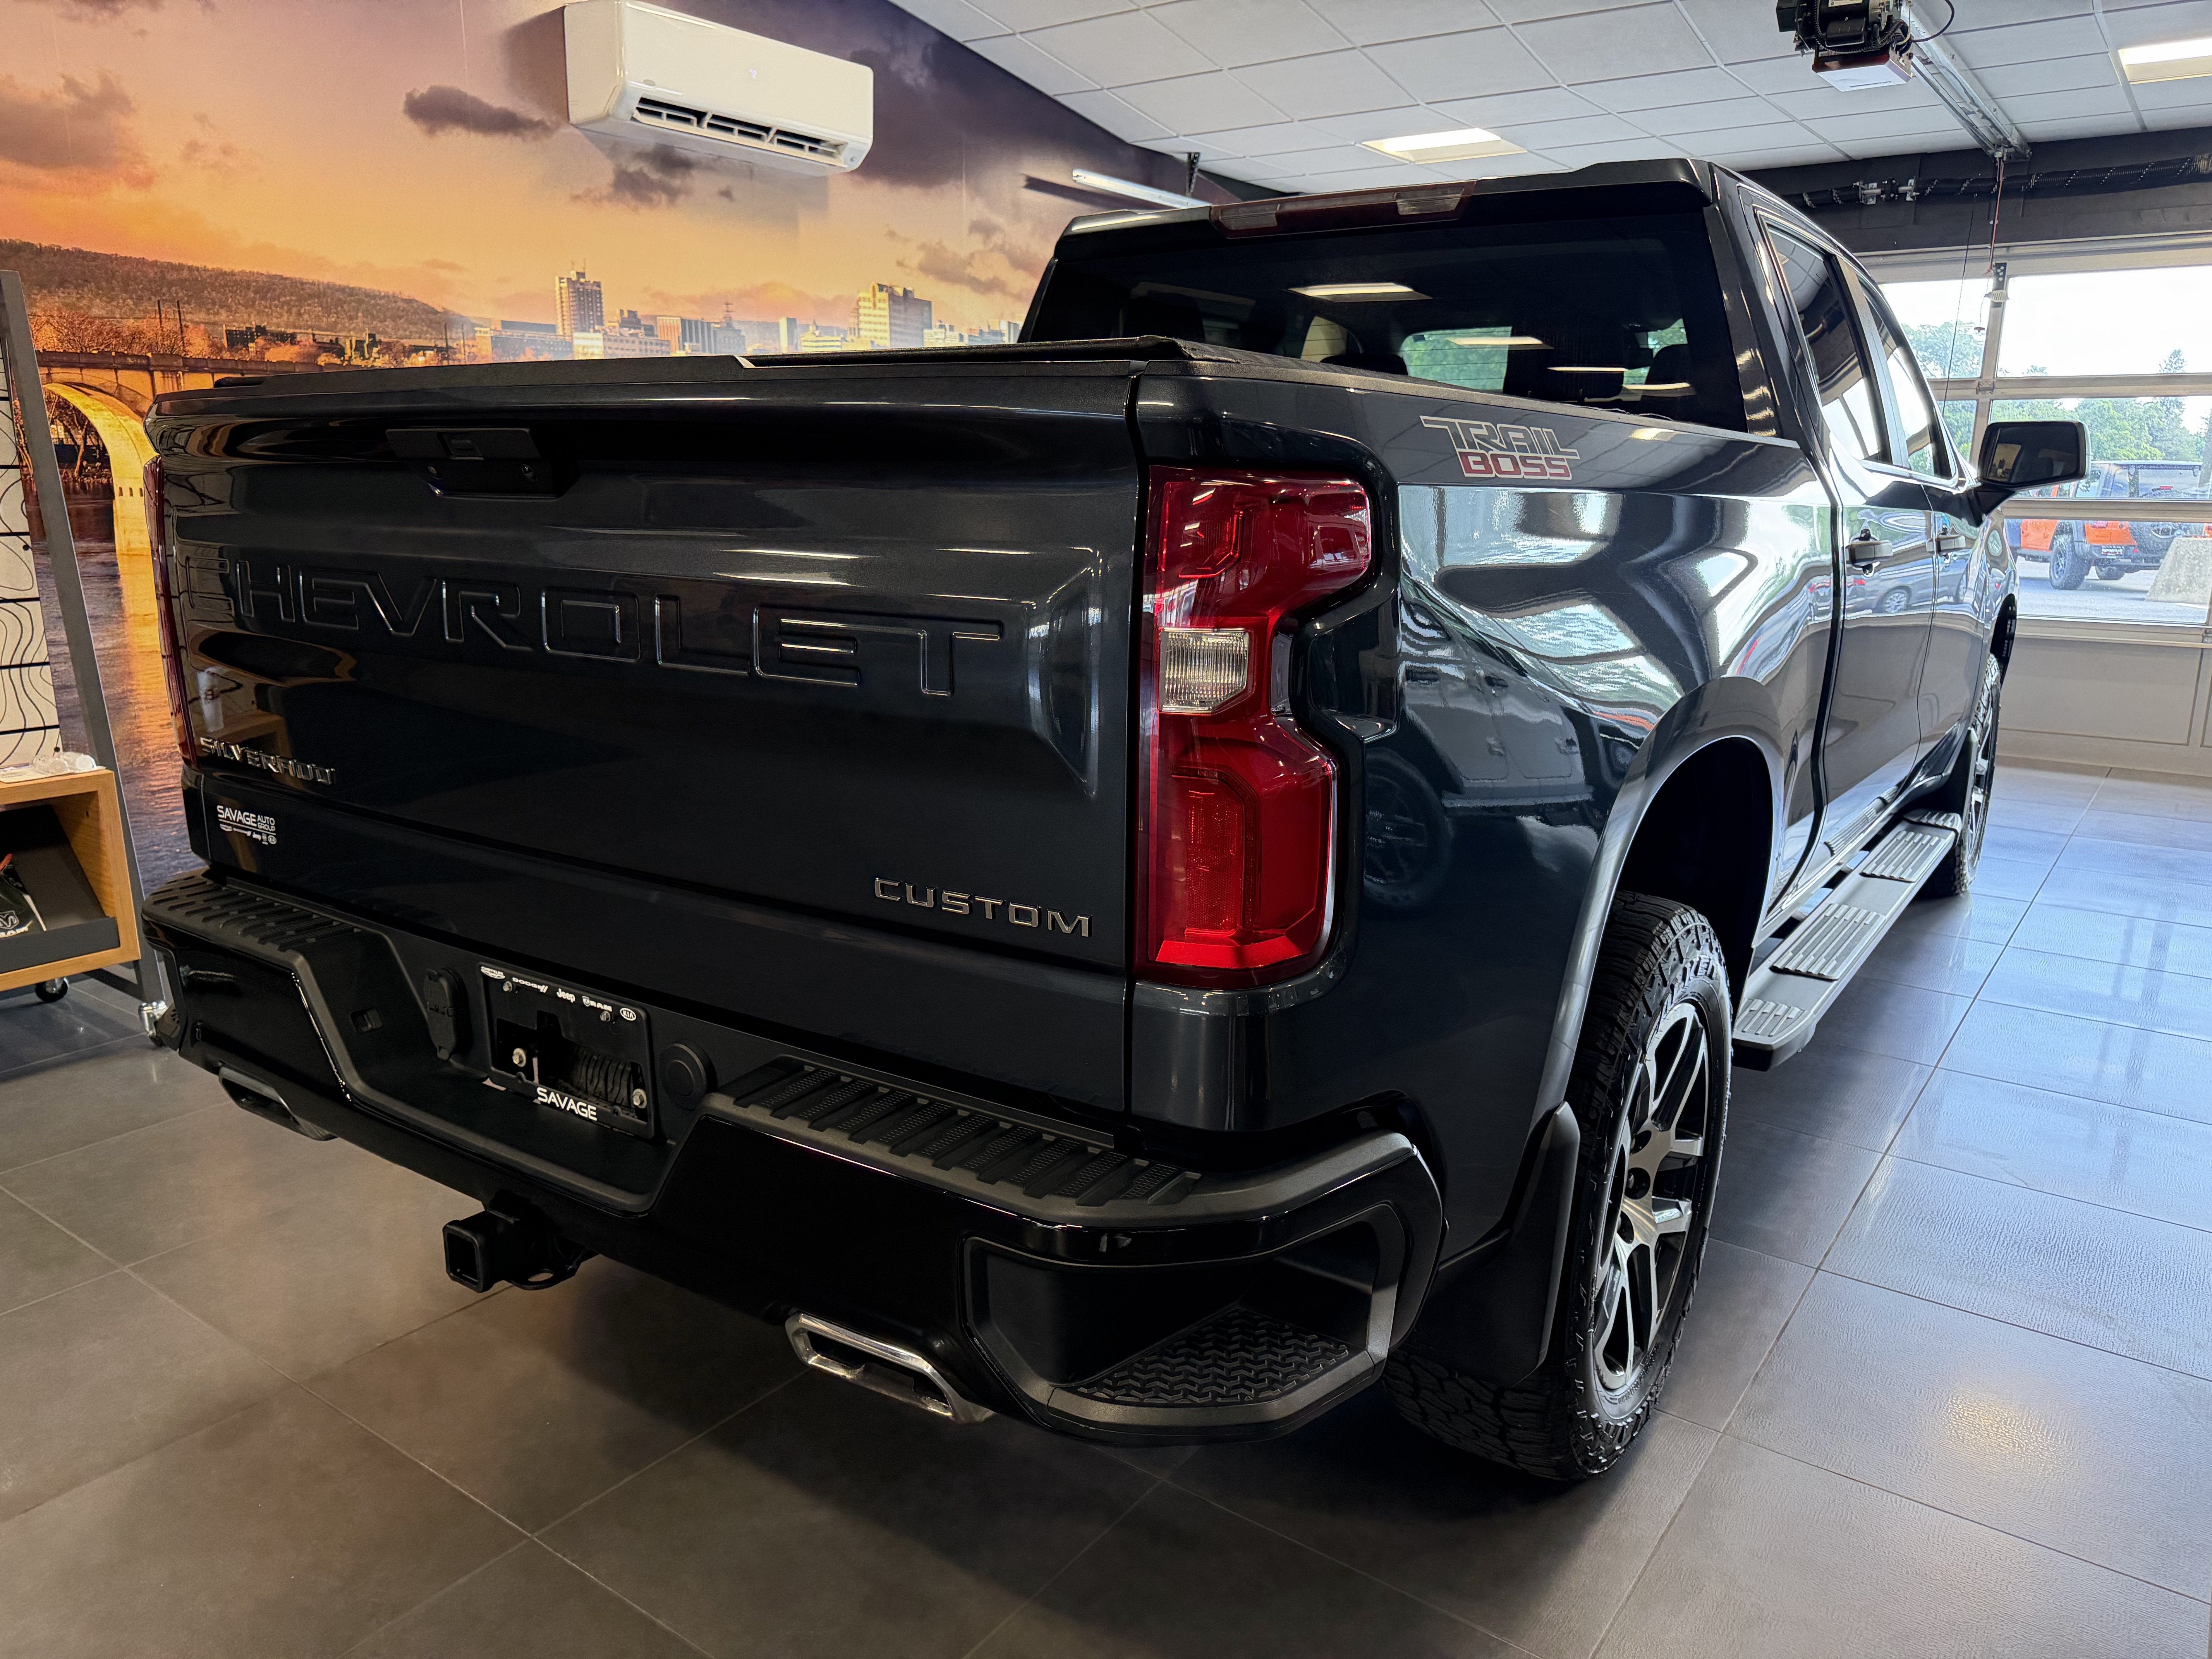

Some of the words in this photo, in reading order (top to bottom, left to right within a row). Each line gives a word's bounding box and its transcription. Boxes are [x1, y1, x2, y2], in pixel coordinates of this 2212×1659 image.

[1420, 415, 1580, 459] TRAIL
[1458, 449, 1572, 480] BOSS
[185, 556, 1002, 696] CHEVROLET
[200, 737, 336, 785] SILVERADO
[217, 805, 257, 827] SAVAGE
[257, 814, 275, 826] AUTO
[258, 823, 276, 831] GROUP
[874, 877, 1092, 937] CUSTOM
[556, 988, 575, 1003] Jeep
[590, 1000, 612, 1012] RAM
[622, 1009, 635, 1019] KIA
[536, 1087, 597, 1121] SAVAGE
